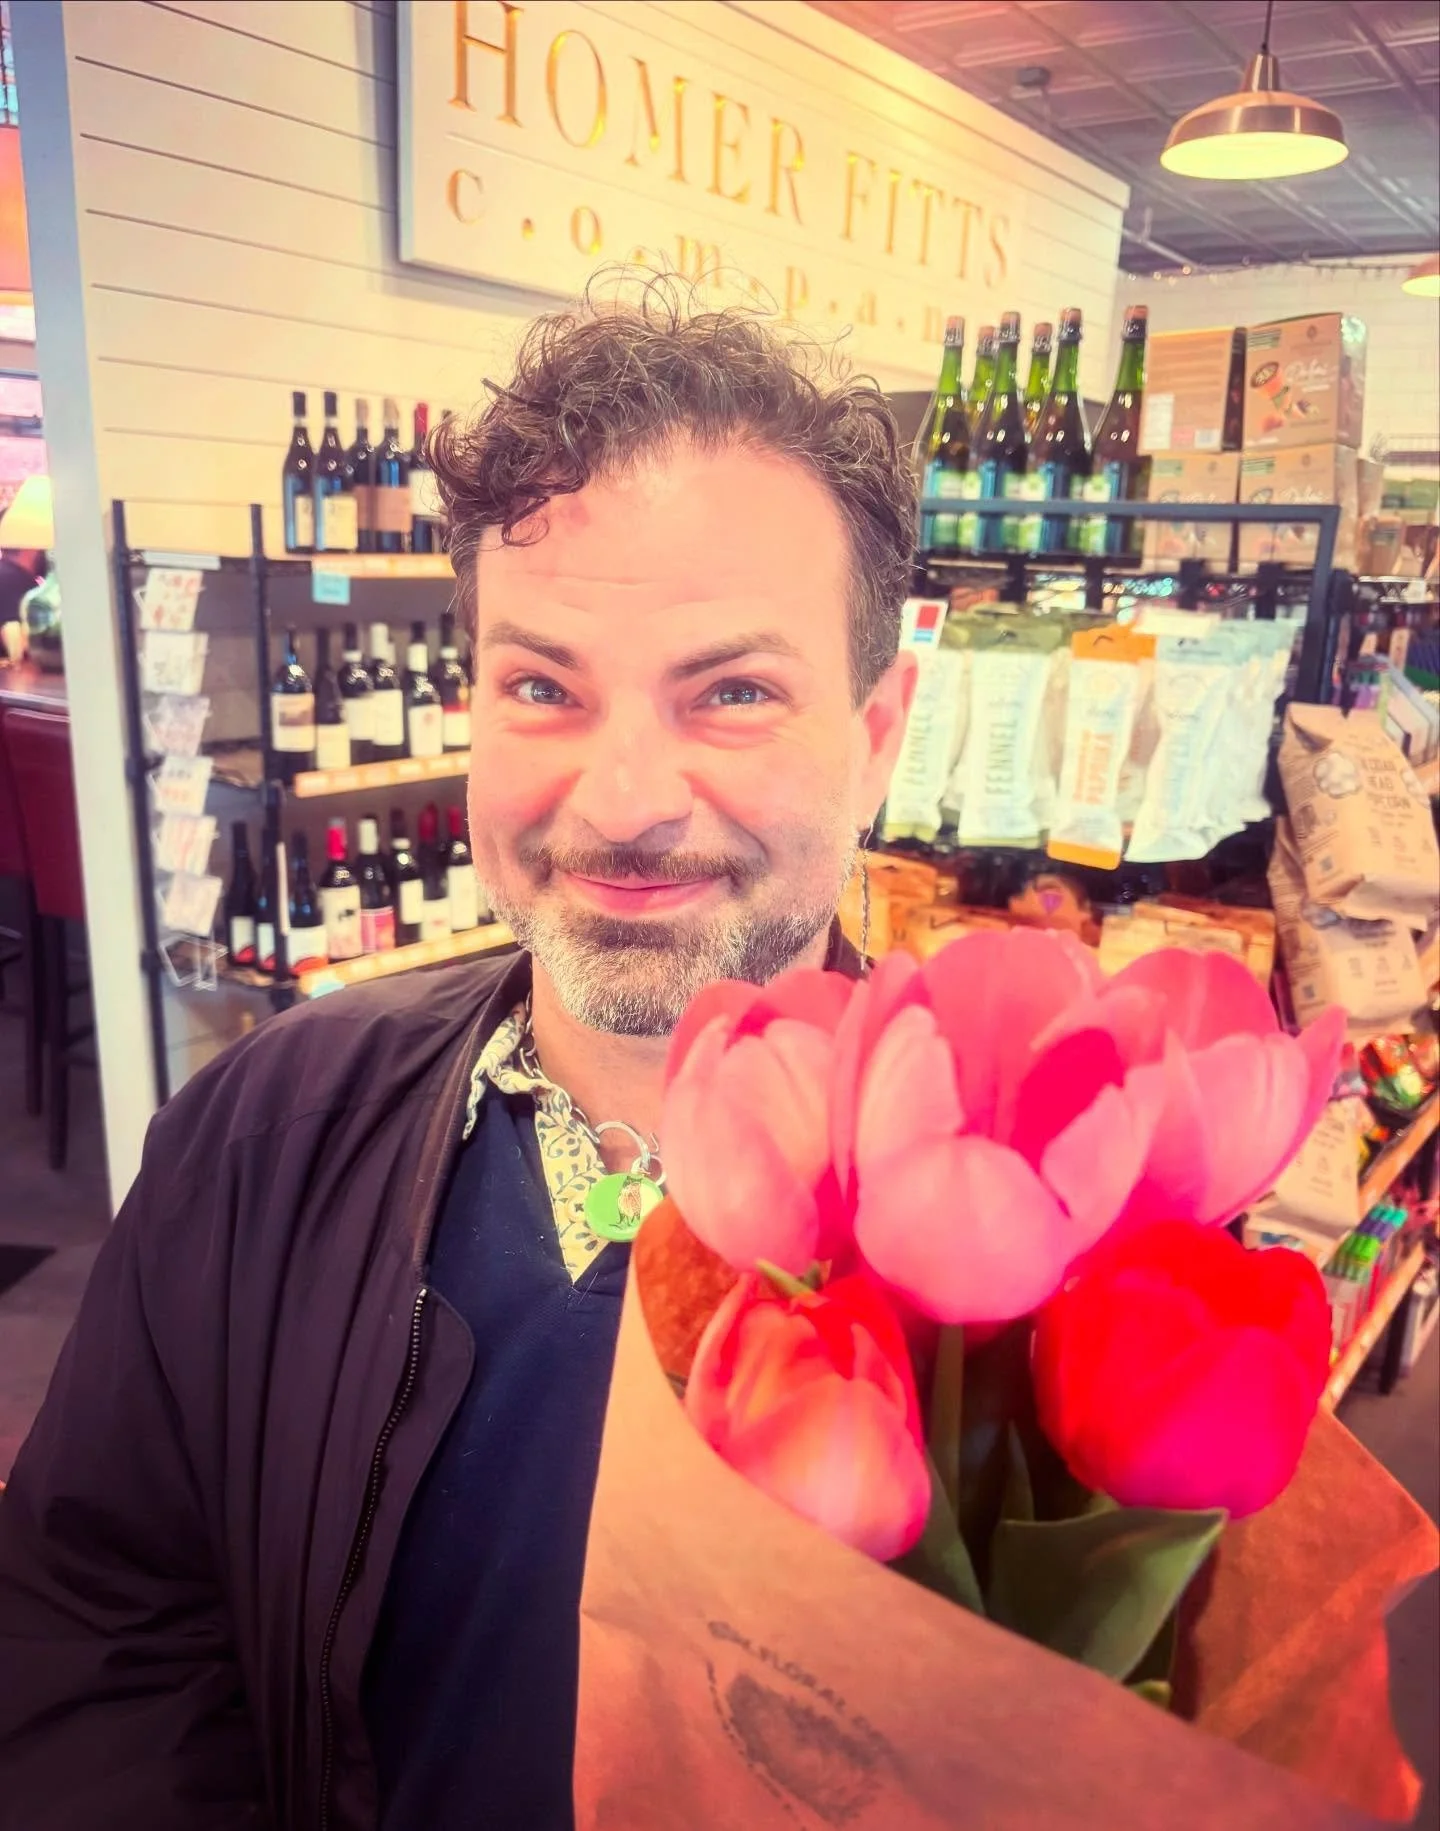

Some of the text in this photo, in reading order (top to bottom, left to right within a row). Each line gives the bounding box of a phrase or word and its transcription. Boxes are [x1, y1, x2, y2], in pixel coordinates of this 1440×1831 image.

[447, 0, 1012, 289] HOMER FITTS
[984, 720, 1018, 795] FENNEL
